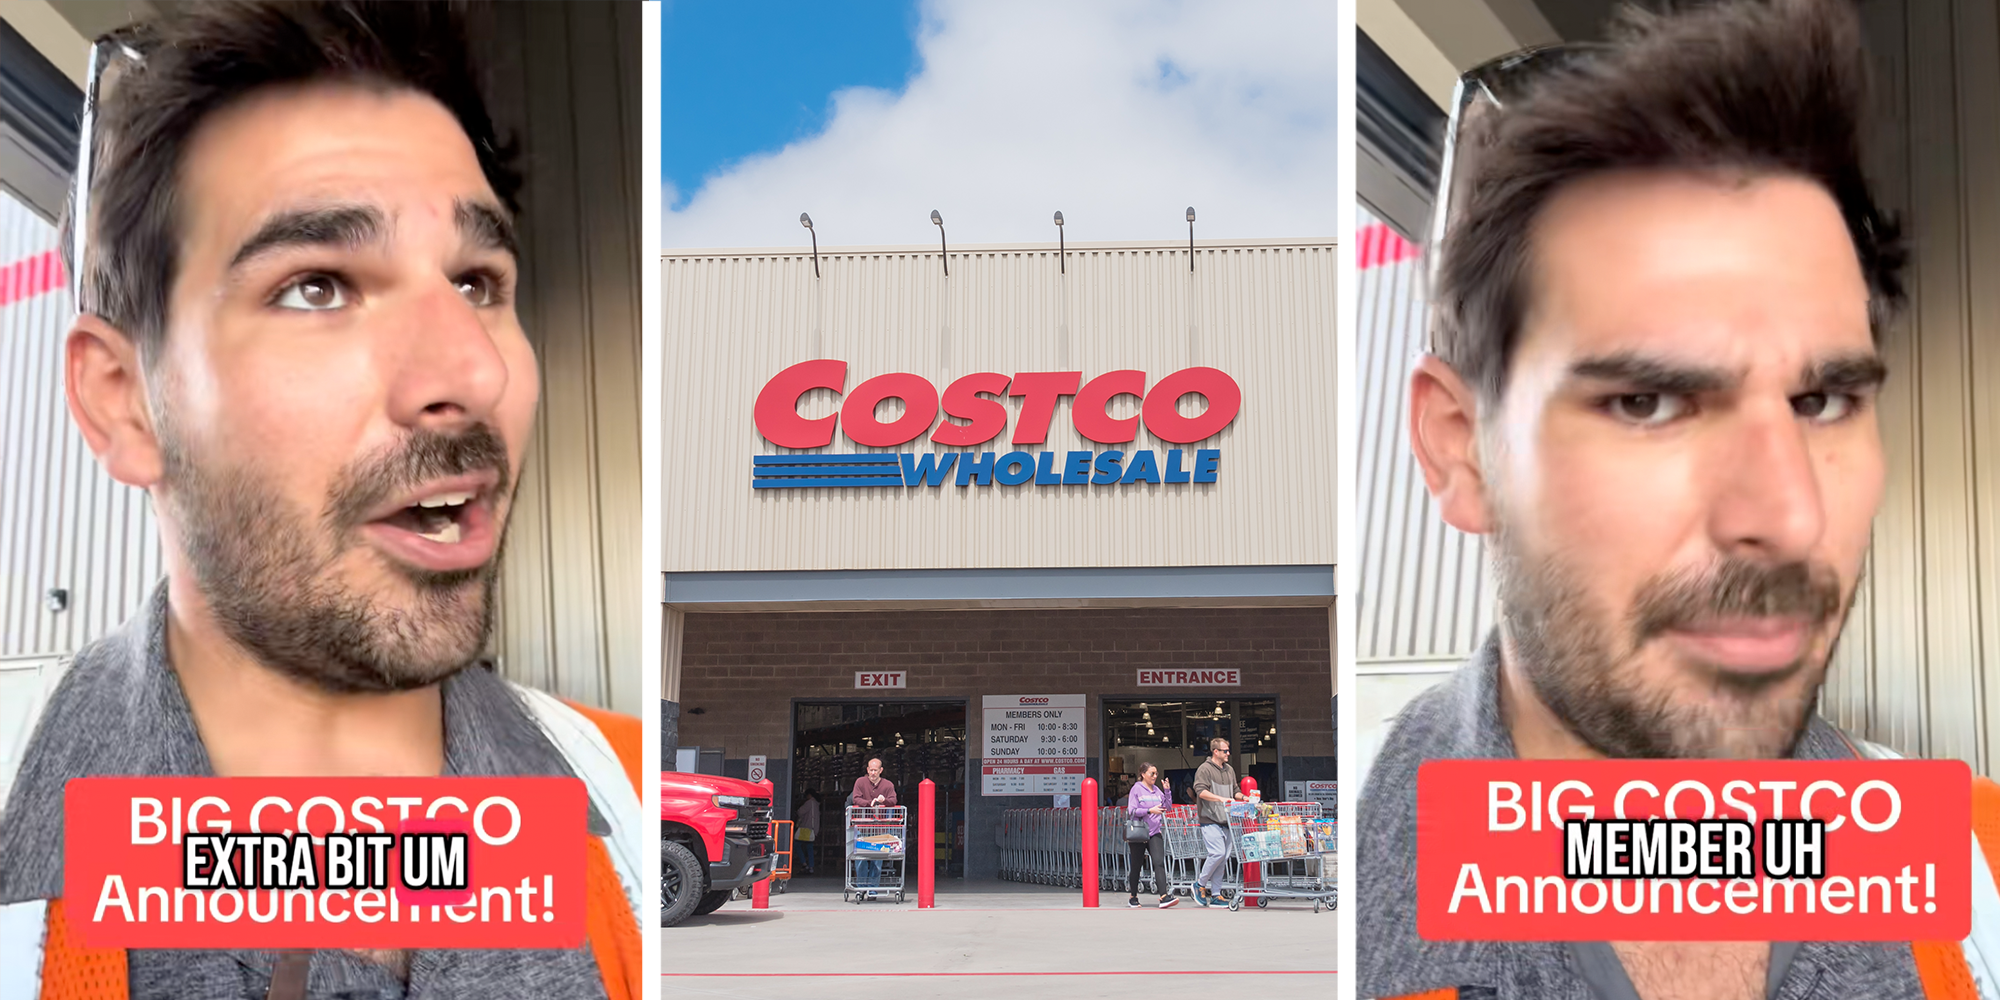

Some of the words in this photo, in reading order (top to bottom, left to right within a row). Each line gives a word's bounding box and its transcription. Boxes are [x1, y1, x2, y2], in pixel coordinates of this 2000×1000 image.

[754, 359, 1242, 449] COSTCO
[900, 449, 1220, 487] WHOLESALE
[860, 673, 901, 686] EXIT
[1140, 670, 1238, 684] ENTRANCE
[1006, 711, 1042, 719] MEMBERS
[1043, 710, 1063, 719] ONLY
[991, 723, 1008, 731] MON
[1014, 723, 1026, 731] FRI
[1037, 722, 1057, 731] 10:00
[1062, 722, 1078, 731] 8:30
[990, 735, 1029, 743] SATURDAY
[1040, 735, 1057, 743] 9:30
[1062, 735, 1078, 743] 6:00
[990, 747, 1020, 756] SUNDAY
[1037, 747, 1057, 755] 10:00
[1062, 747, 1078, 755] 6:00
[992, 767, 1025, 775] PHARMACY
[1053, 766, 1066, 774] GAS
